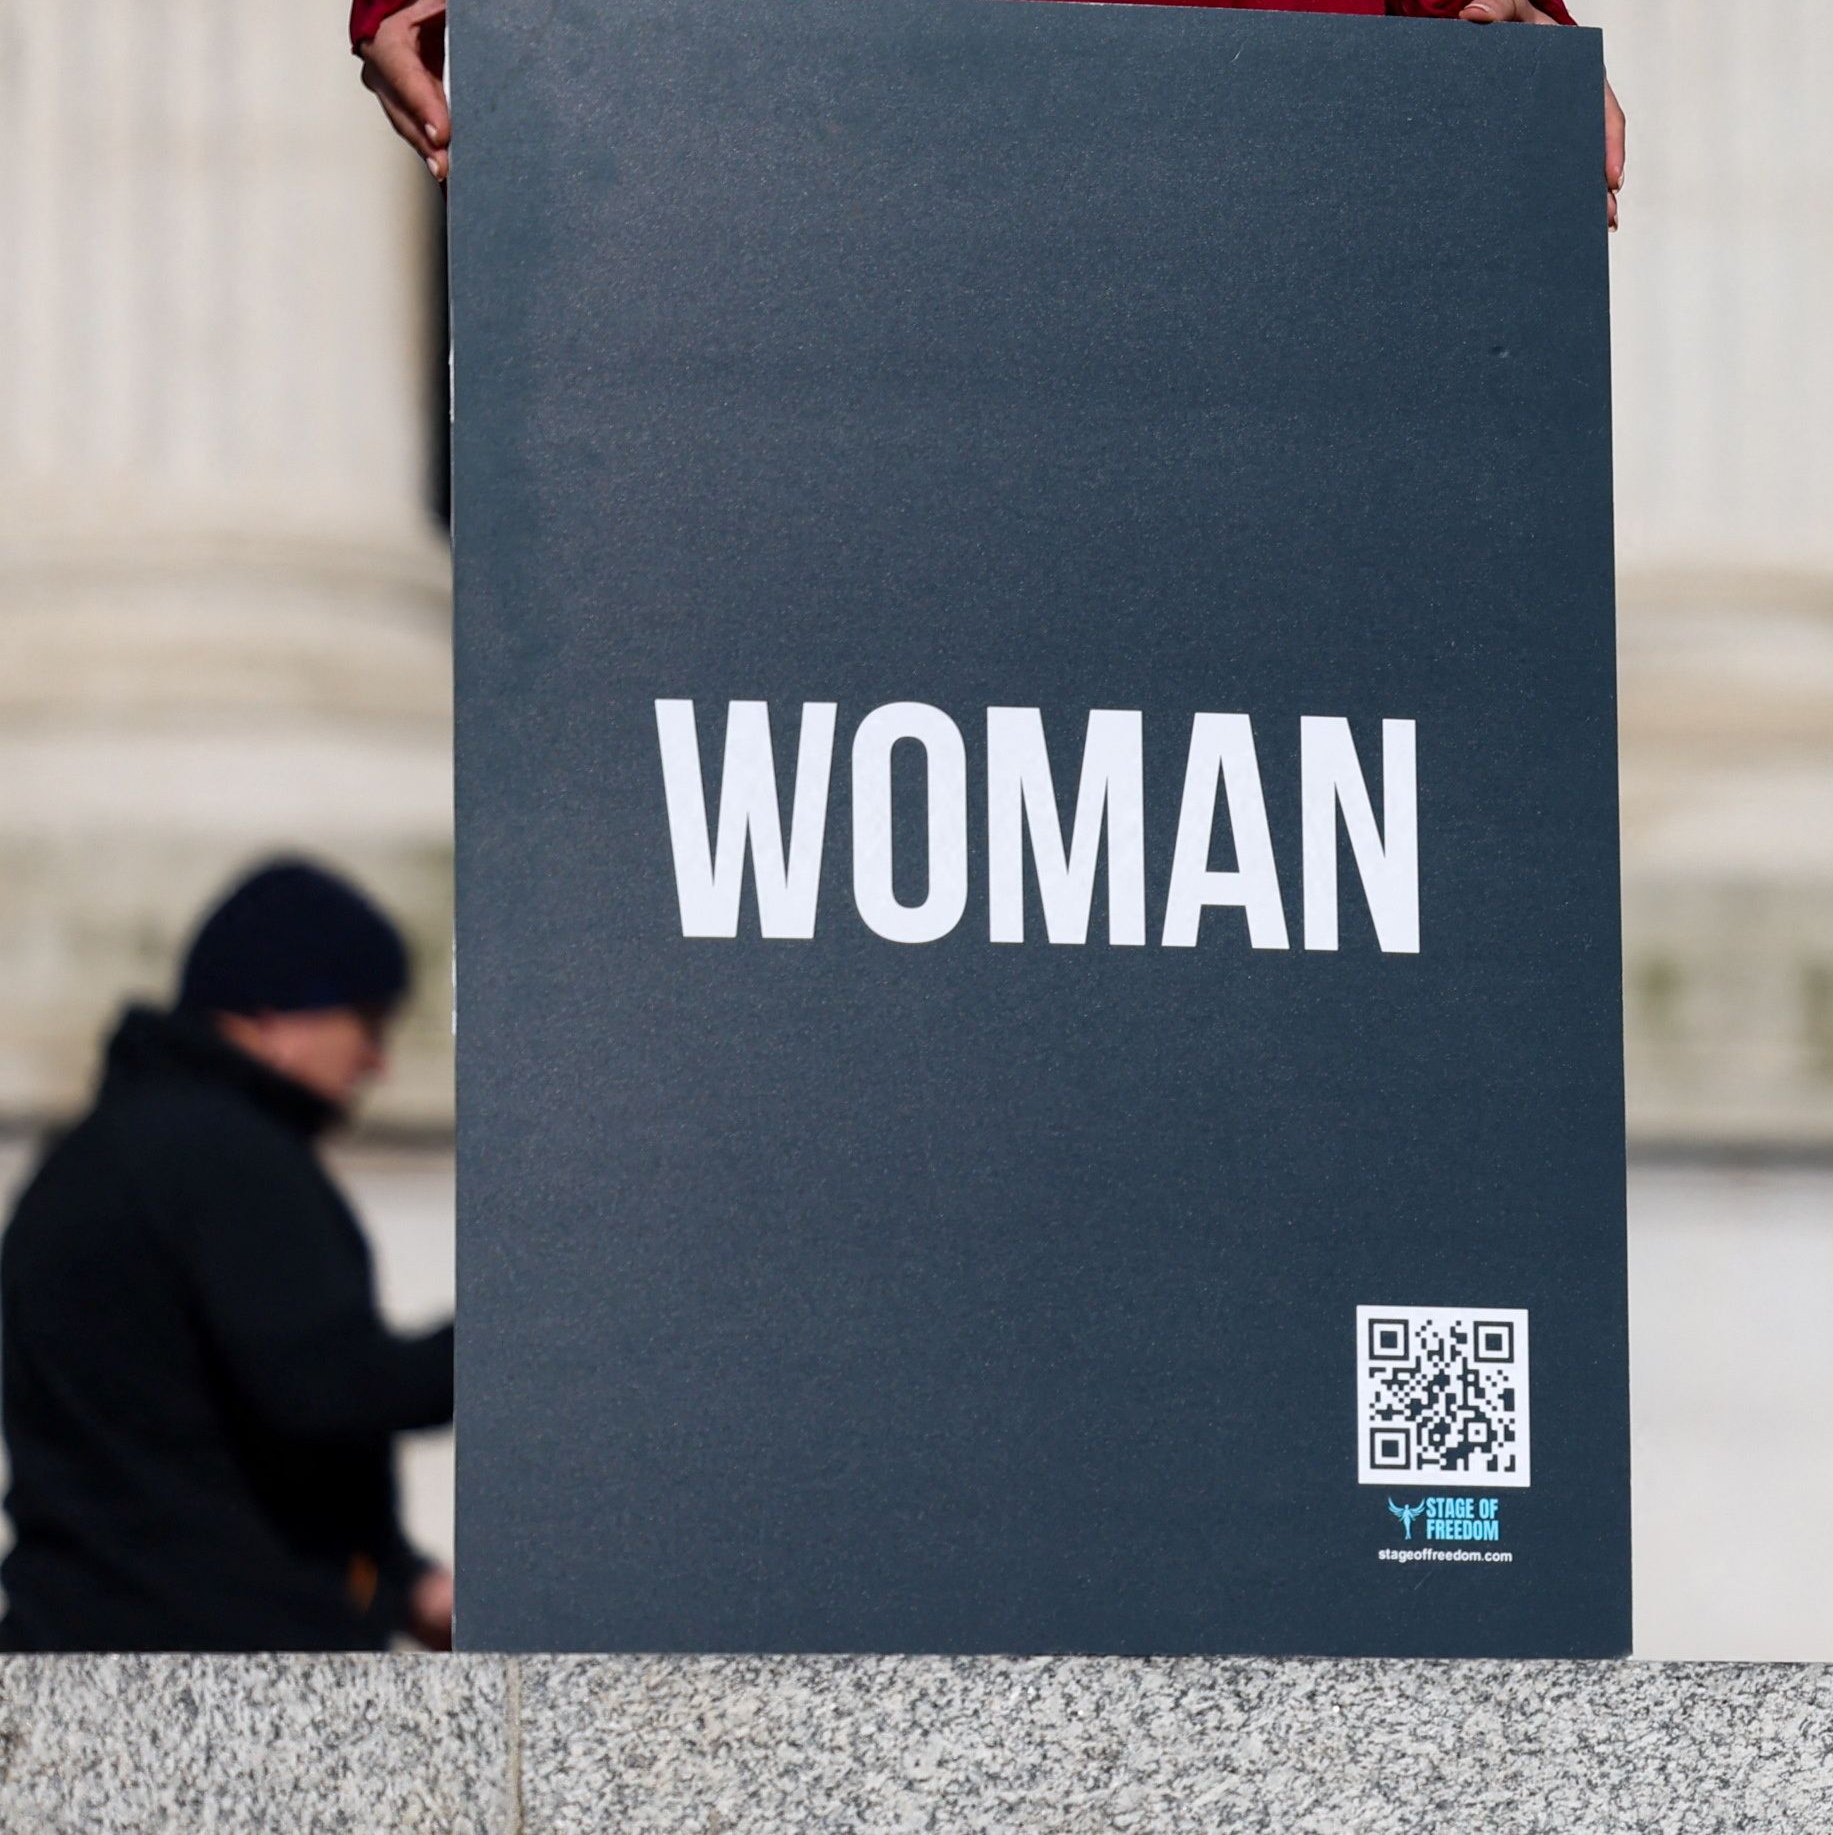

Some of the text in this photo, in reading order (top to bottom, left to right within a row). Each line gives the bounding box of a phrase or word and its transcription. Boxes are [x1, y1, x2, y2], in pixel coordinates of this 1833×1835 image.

[655, 698, 1421, 954] WOMAN
[1426, 1496, 1499, 1519] STAGE OF
[1426, 1519, 1500, 1541] FREEDOM
[1377, 1547, 1513, 1563] stageoffreedom.com
